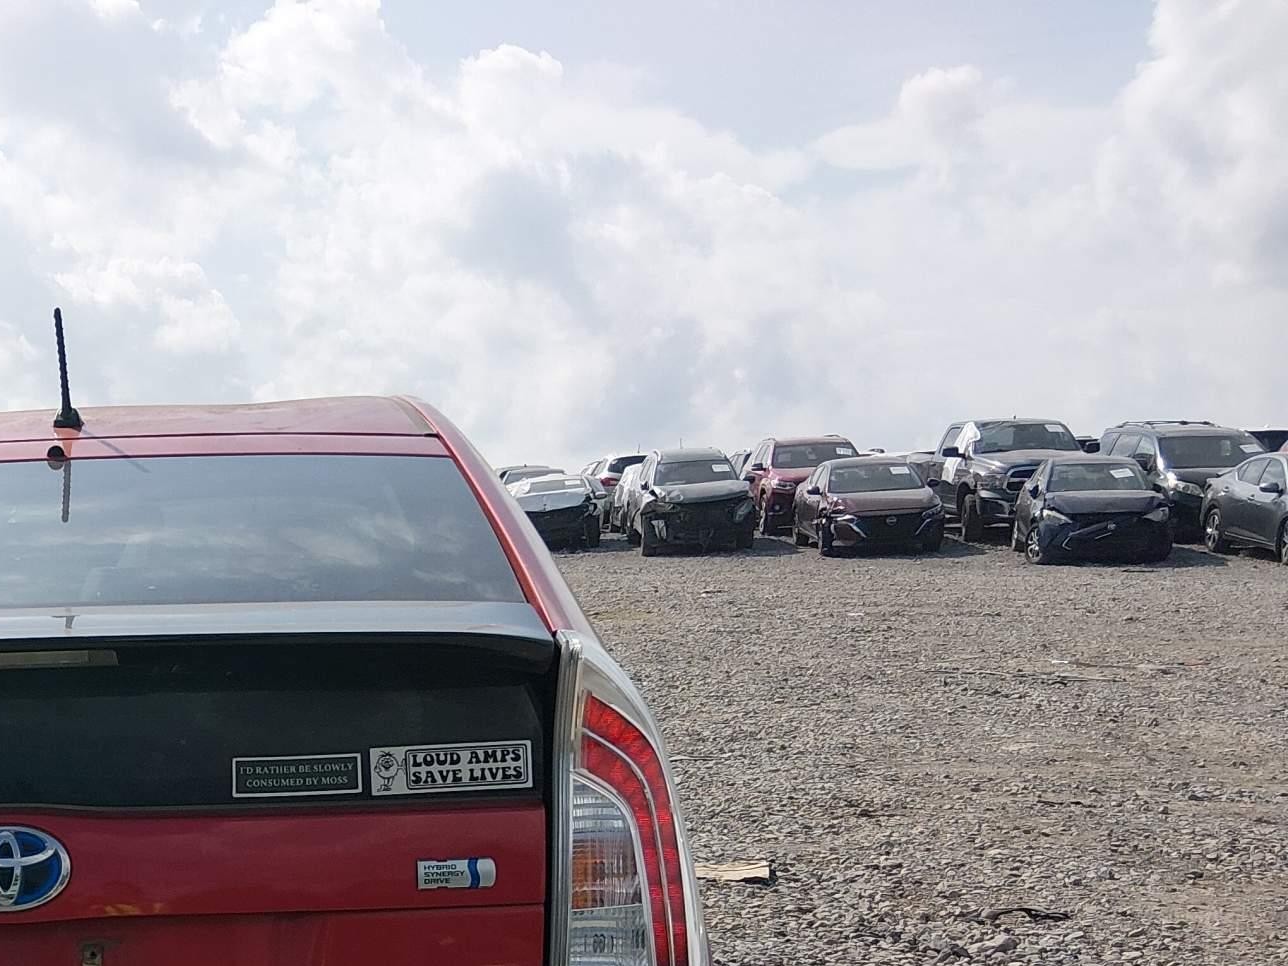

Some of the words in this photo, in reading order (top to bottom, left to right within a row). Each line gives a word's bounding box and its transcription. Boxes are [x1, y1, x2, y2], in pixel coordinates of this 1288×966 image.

[411, 751, 461, 768] LOUD
[467, 749, 522, 765] AMPS
[239, 766, 254, 775] I'D
[255, 765, 296, 774] RATHER
[298, 764, 311, 773] BE
[312, 762, 354, 772] SLOWLY
[246, 778, 304, 788] CONSUMED
[305, 777, 319, 786] BY
[320, 776, 349, 785] MOSS
[411, 768, 463, 785] SAVE
[468, 766, 524, 782] LIVES
[423, 877, 451, 885] DRIVE
